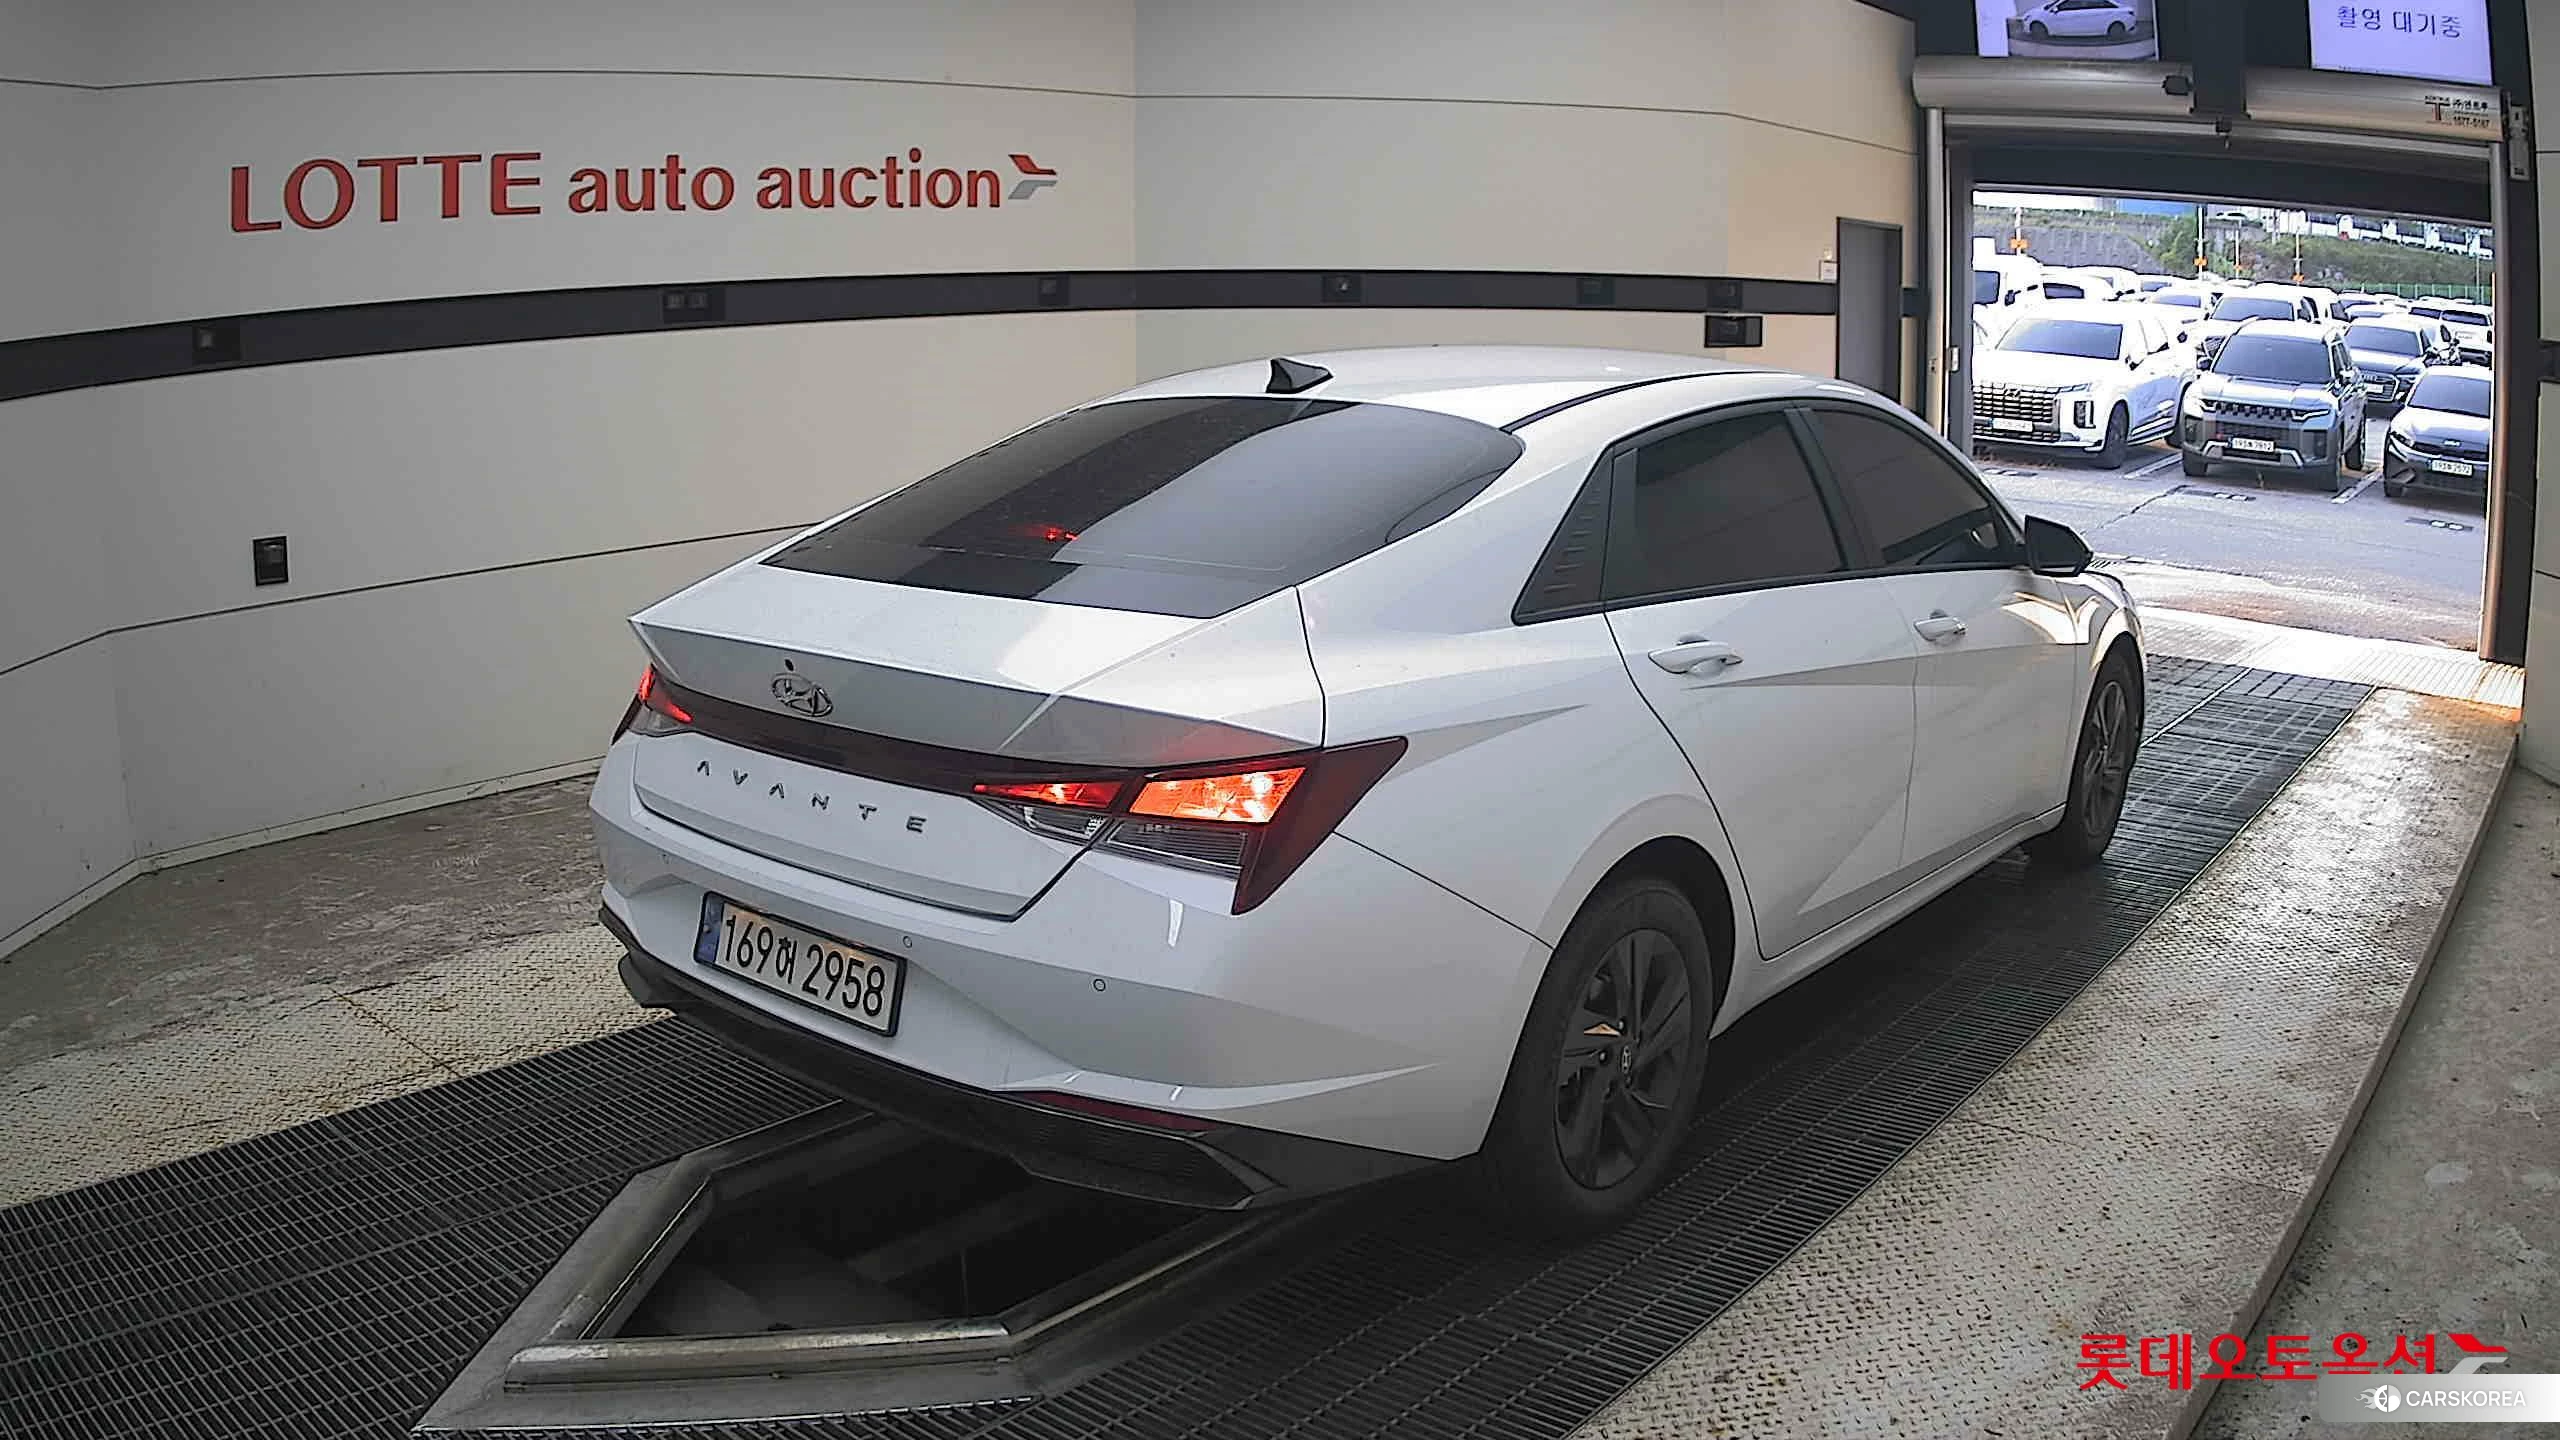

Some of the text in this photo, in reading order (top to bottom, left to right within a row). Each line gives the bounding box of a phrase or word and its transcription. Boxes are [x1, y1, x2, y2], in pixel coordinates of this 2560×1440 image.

[2337, 5, 2461, 39] 촬영 대기중
[229, 147, 1002, 233] LOTTE auto auction
[696, 760, 928, 834] AVANTE
[801, 943, 886, 1017] 2958
